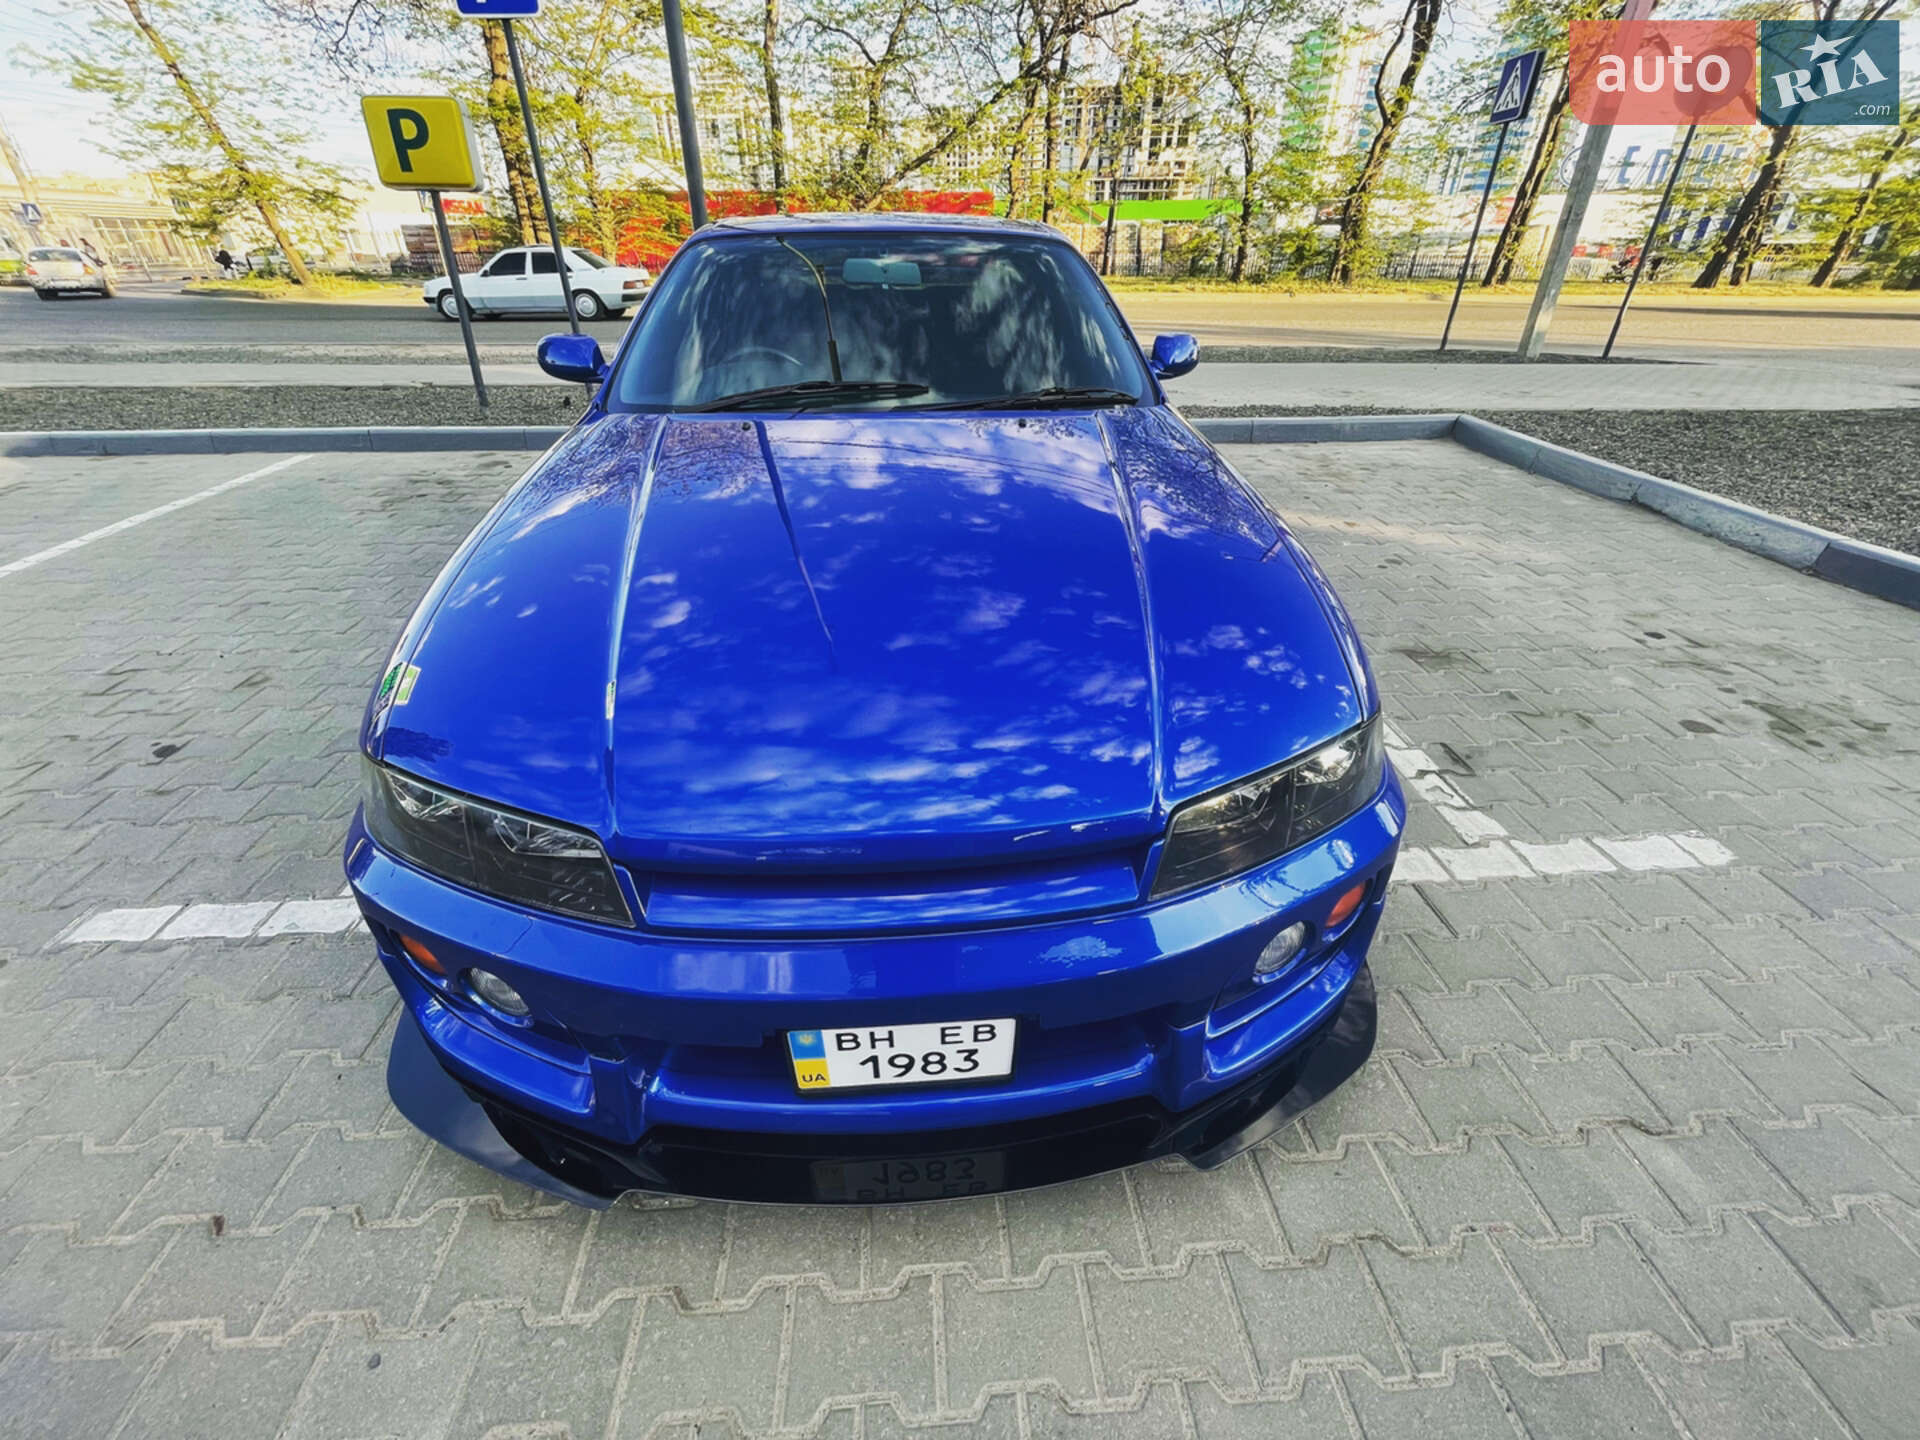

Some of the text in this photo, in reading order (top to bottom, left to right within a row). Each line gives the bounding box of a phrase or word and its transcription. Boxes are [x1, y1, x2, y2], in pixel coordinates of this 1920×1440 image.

[386, 108, 430, 173] P
[835, 1024, 998, 1051] BH EB
[801, 1073, 827, 1083] UA
[859, 1048, 980, 1079] 1983
